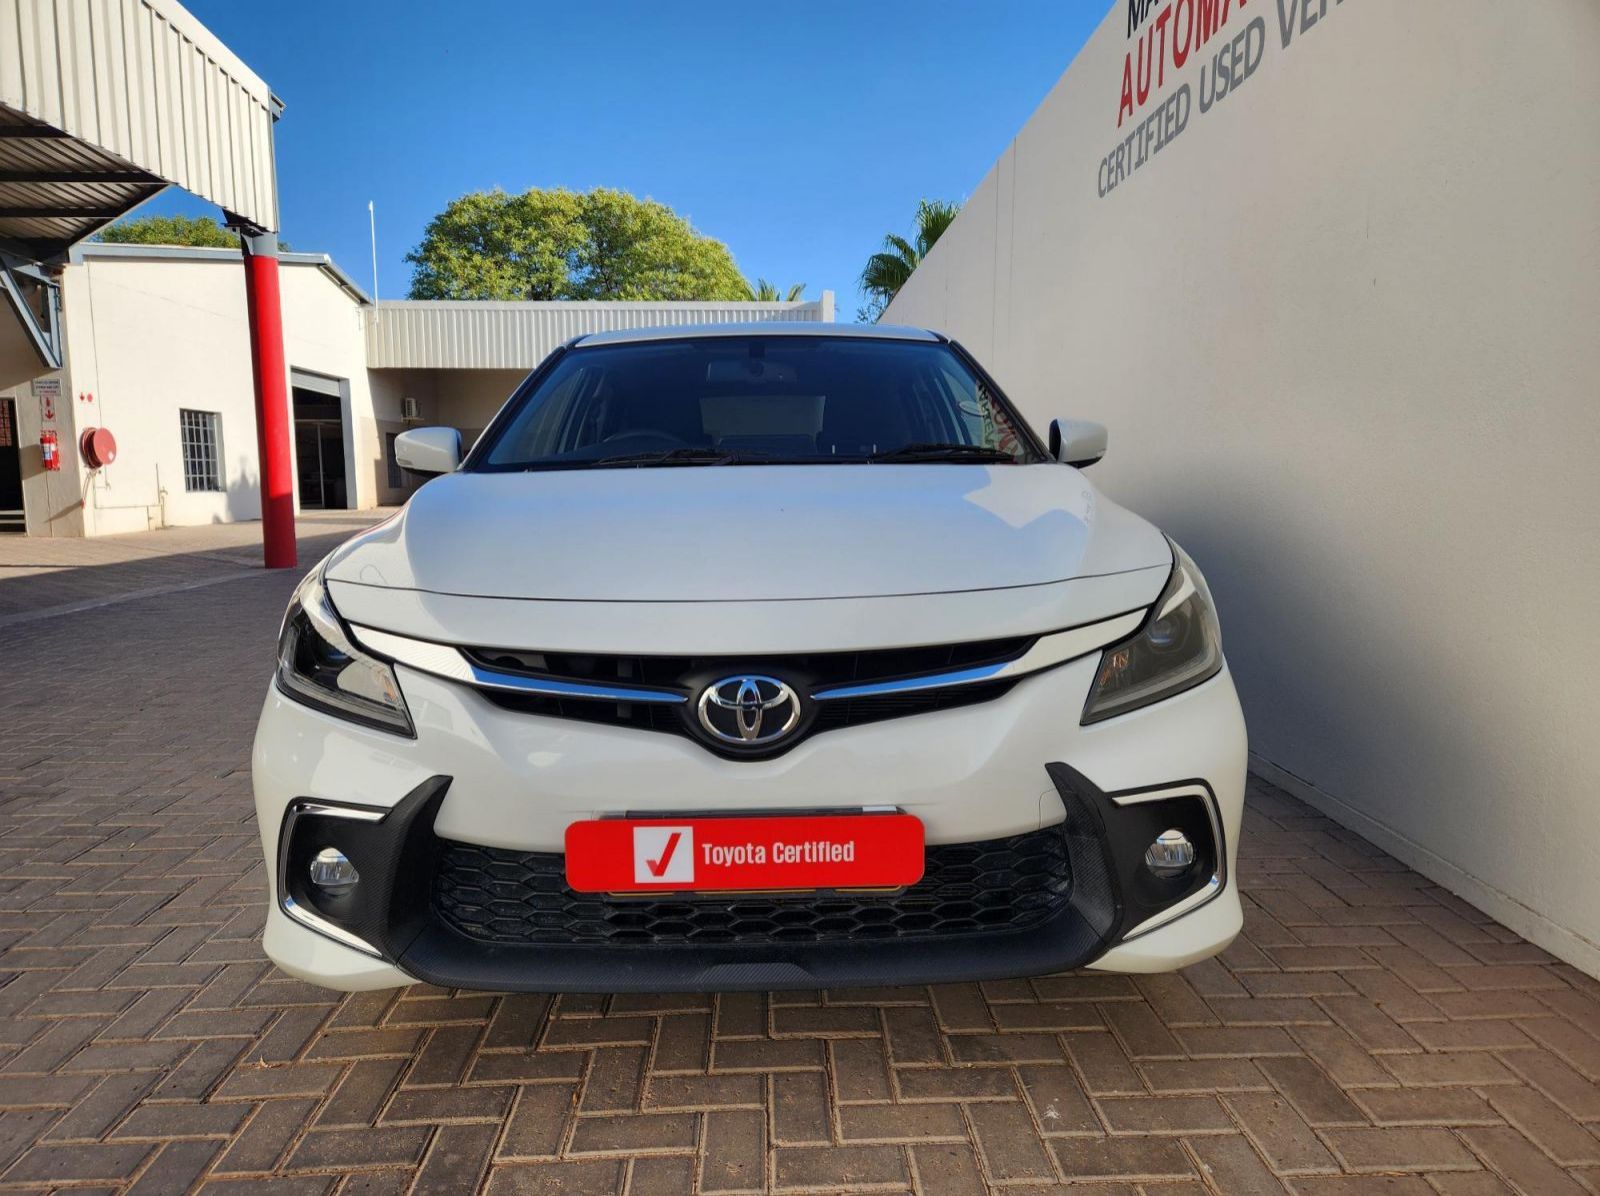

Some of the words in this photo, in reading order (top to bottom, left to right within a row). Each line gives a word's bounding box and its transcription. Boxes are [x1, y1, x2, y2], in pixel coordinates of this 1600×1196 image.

[1098, 83, 1191, 199] CERTIFIED
[1199, 16, 1265, 114] USED
[1117, 0, 1246, 128] AUTOM
[702, 843, 766, 867] Toyota
[772, 841, 855, 864] Certified
